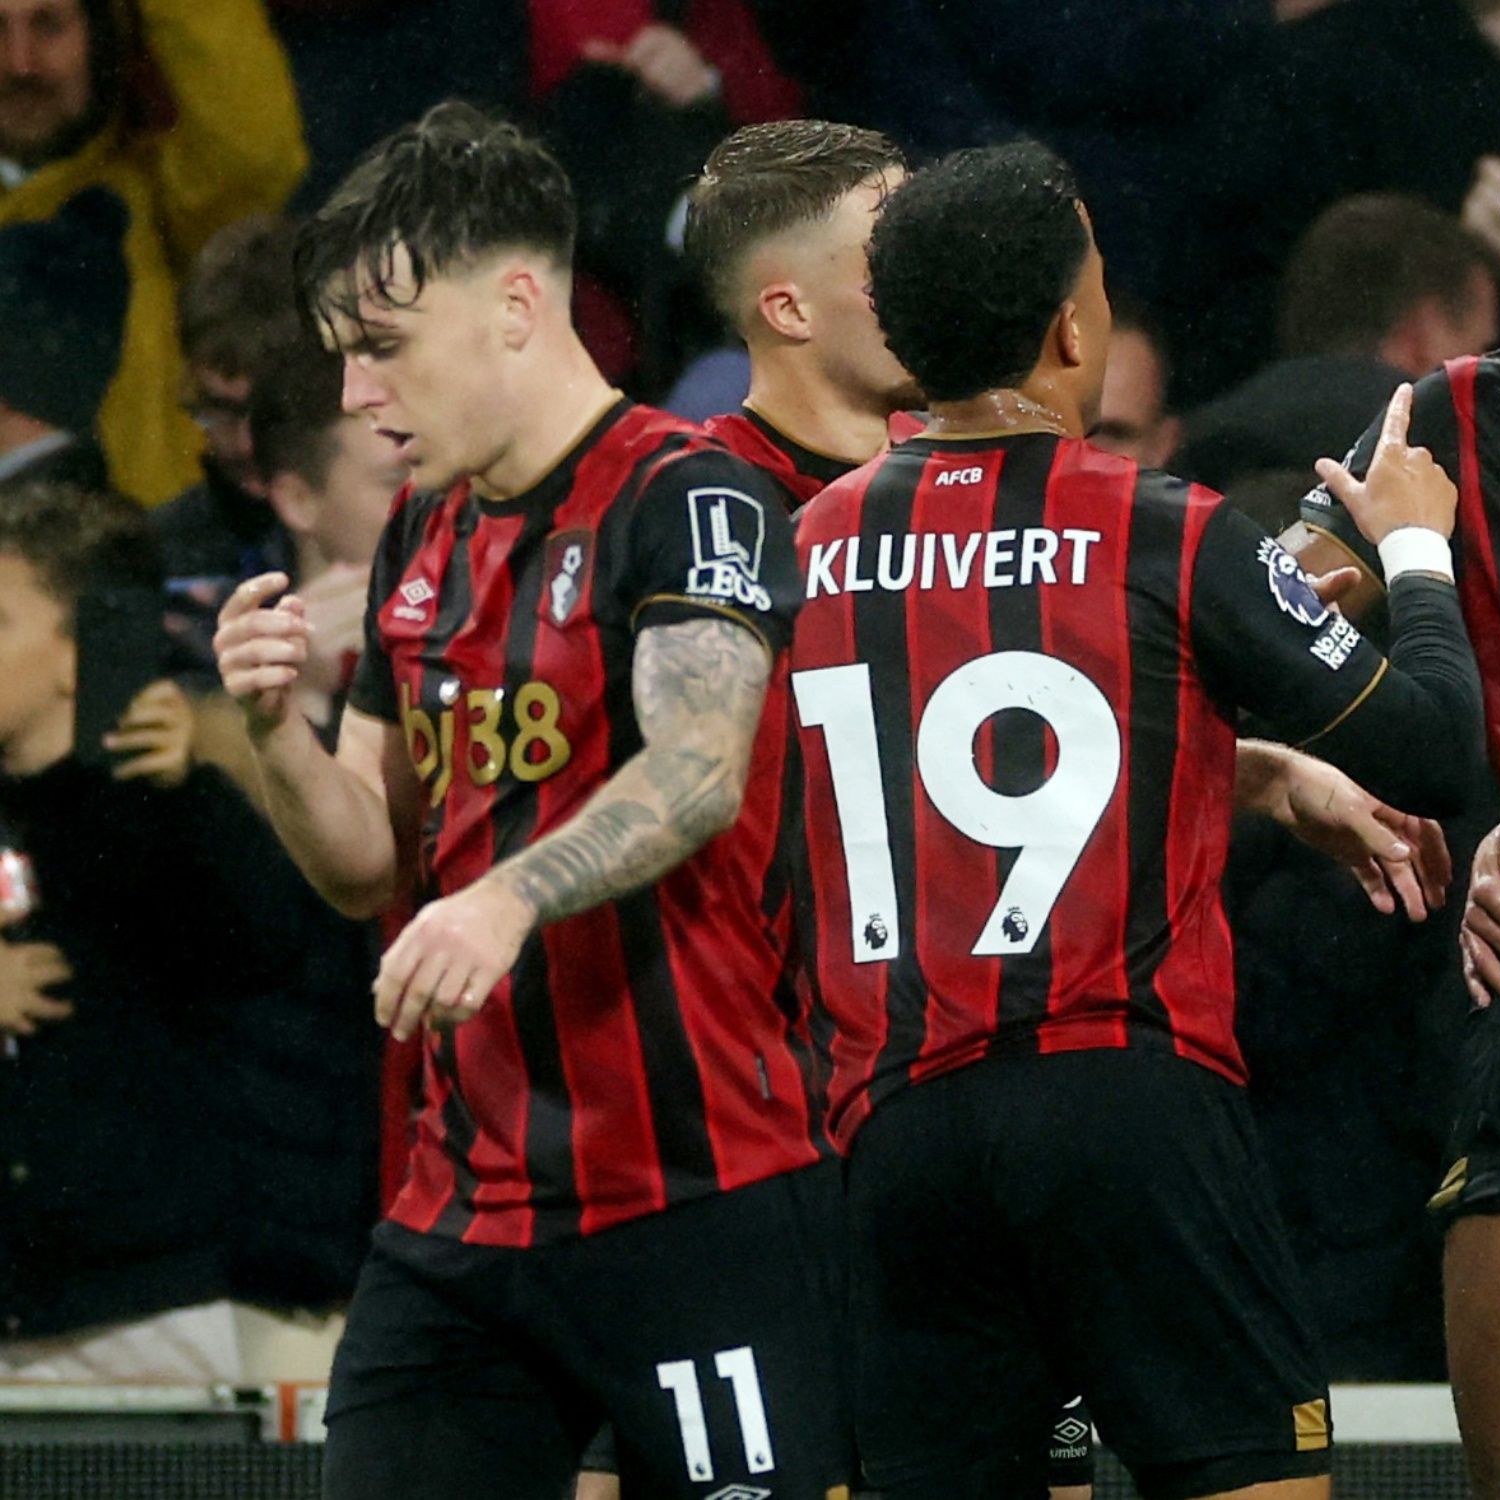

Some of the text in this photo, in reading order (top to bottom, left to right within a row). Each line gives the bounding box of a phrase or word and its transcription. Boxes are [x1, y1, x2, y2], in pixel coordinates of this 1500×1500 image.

[935, 466, 983, 487] AFCB
[806, 528, 1101, 599] KLUIVERT
[791, 650, 1121, 964] 19
[656, 1346, 775, 1482] 11
